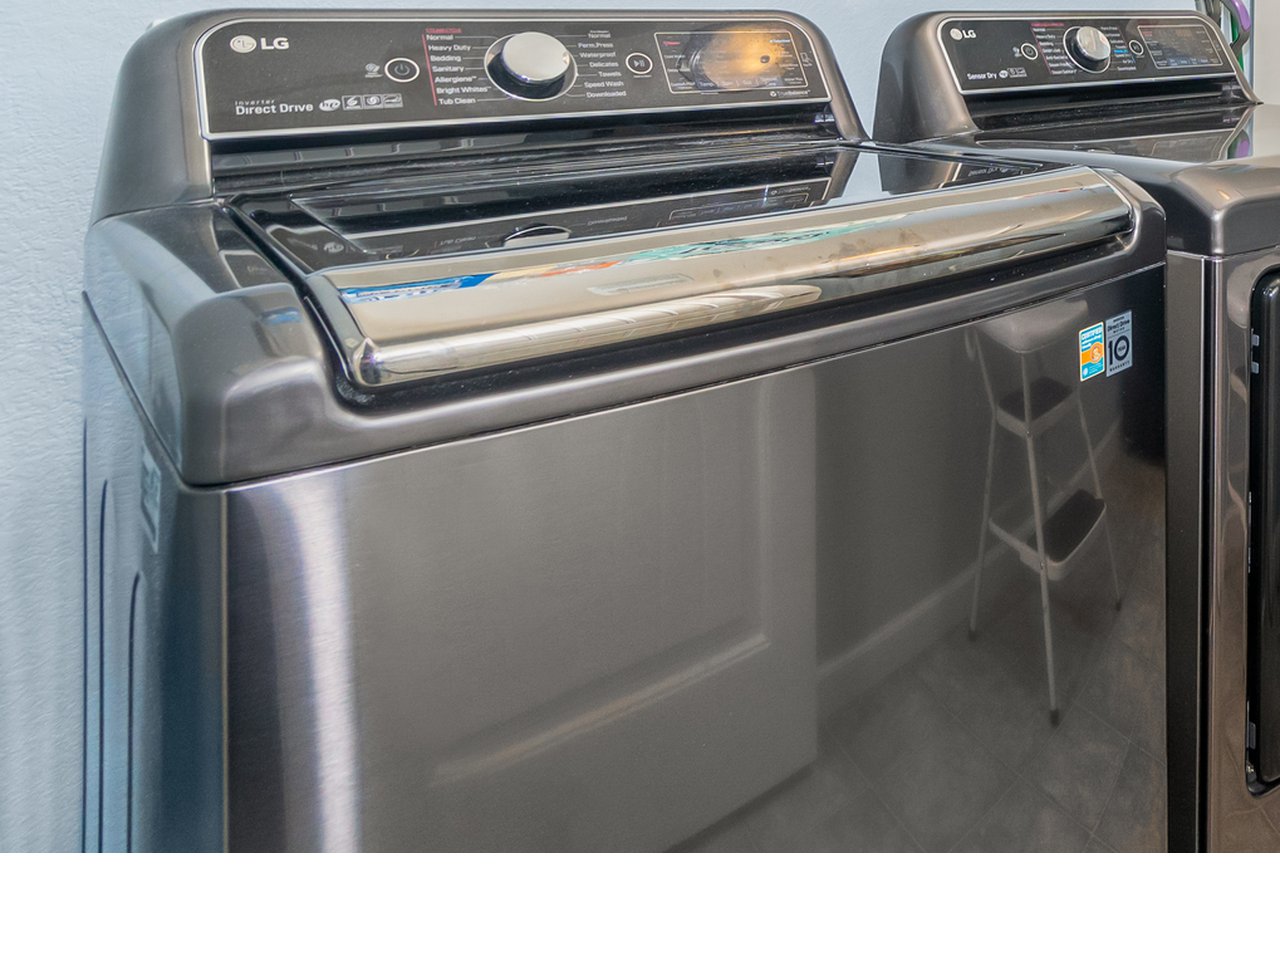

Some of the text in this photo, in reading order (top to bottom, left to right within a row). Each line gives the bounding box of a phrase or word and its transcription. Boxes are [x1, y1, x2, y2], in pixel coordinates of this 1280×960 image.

[962, 29, 977, 39] LG
[260, 37, 290, 50] LG
[428, 44, 472, 52] Heavy Duty
[432, 65, 465, 73] Sanitary
[436, 87, 461, 95] Bright
[235, 105, 277, 116] Direct
[279, 103, 314, 113] Drive
[1108, 335, 1130, 366] 10
